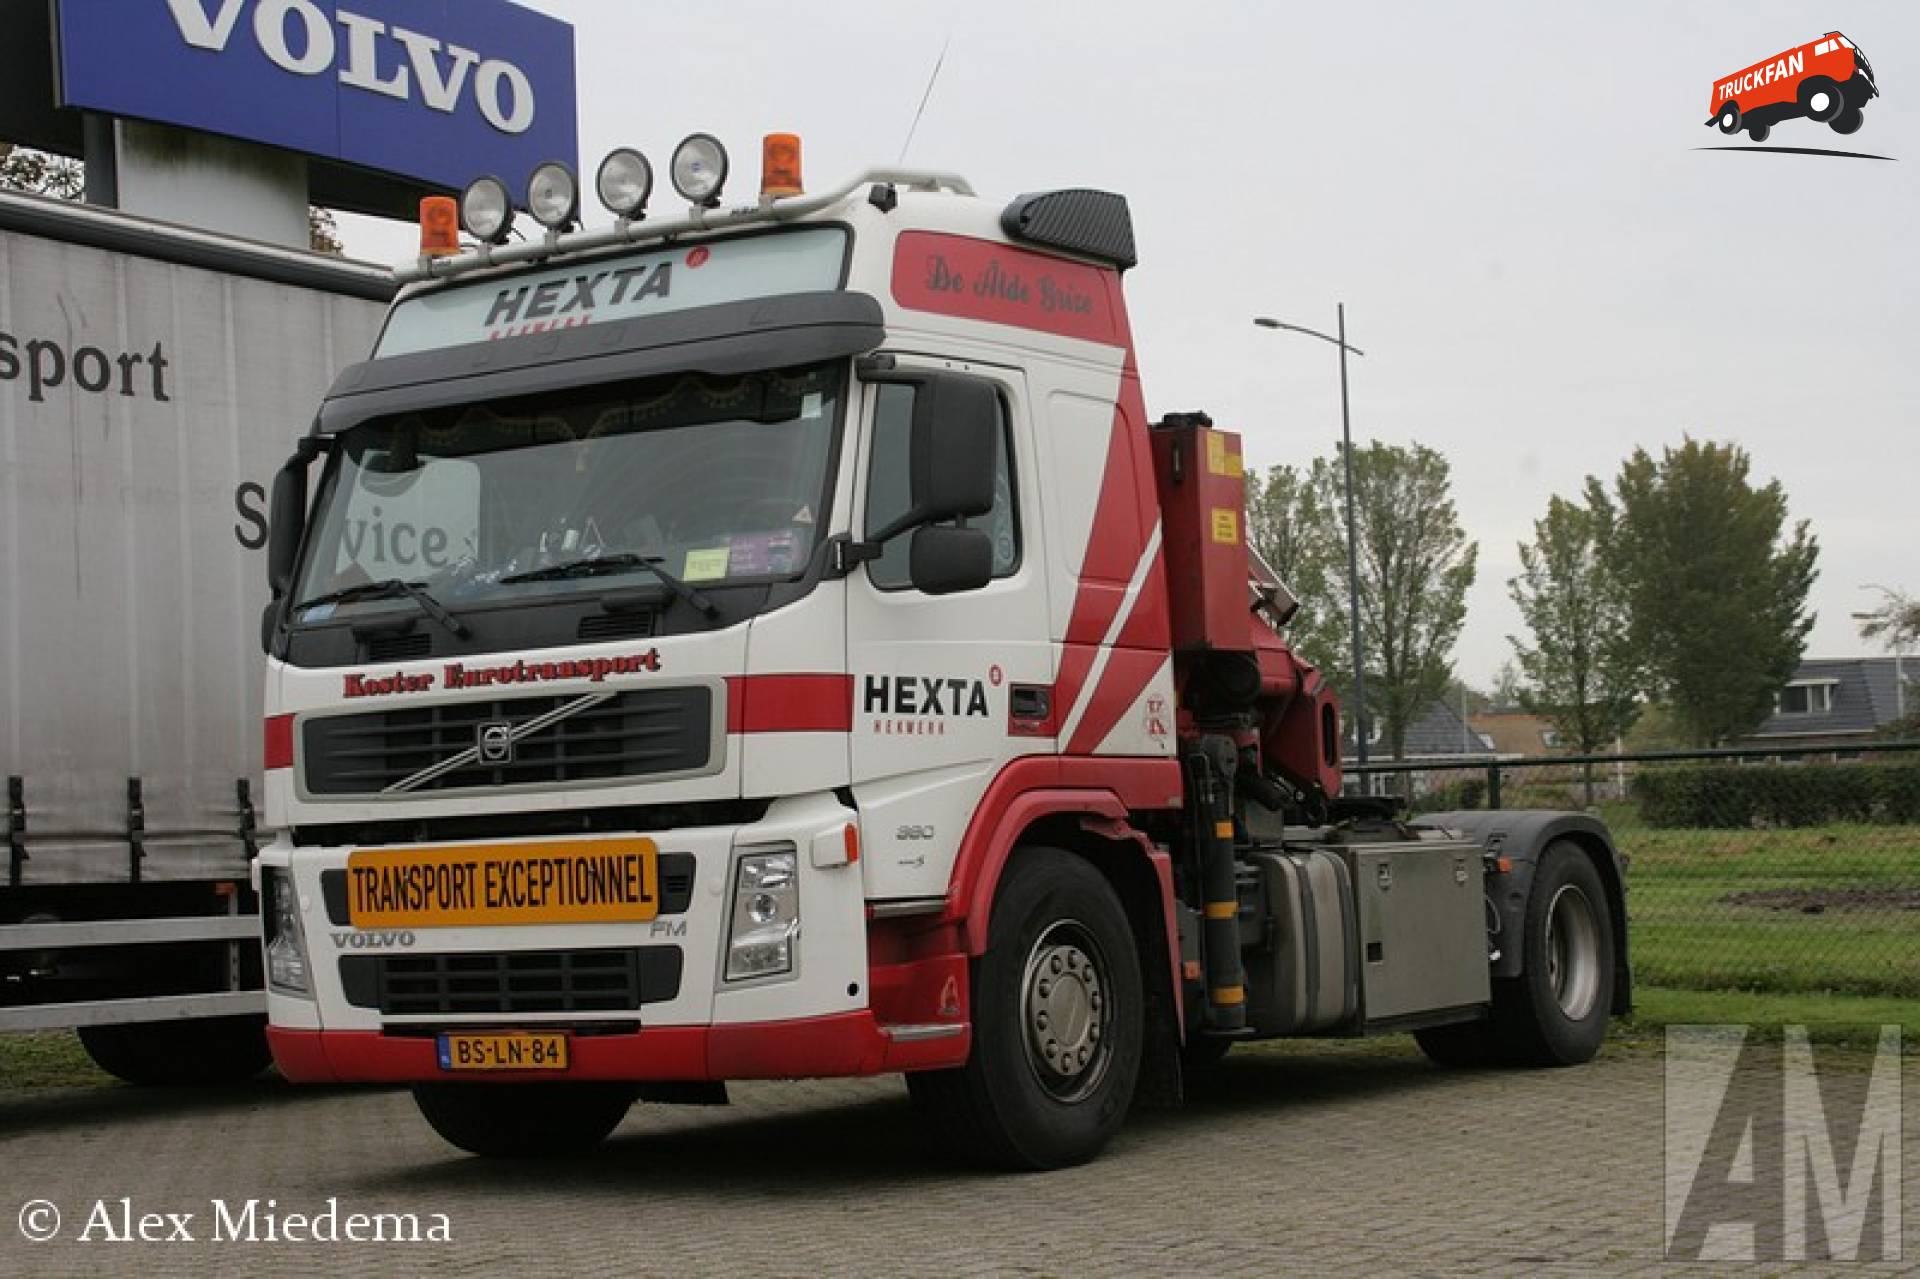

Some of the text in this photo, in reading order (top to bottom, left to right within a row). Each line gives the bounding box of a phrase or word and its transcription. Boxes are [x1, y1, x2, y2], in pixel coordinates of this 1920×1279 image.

[166, 0, 534, 133] VOLVO
[484, 261, 672, 327] HEXTA
[343, 648, 661, 698] Koster Eurotransport
[863, 674, 989, 717] HEXTA
[353, 854, 653, 913] TRANSPORT EXCEPTIONNEL
[330, 930, 416, 949] VOLVO
[650, 920, 688, 937] FM
[457, 1040, 560, 1064] BS-LN-84
